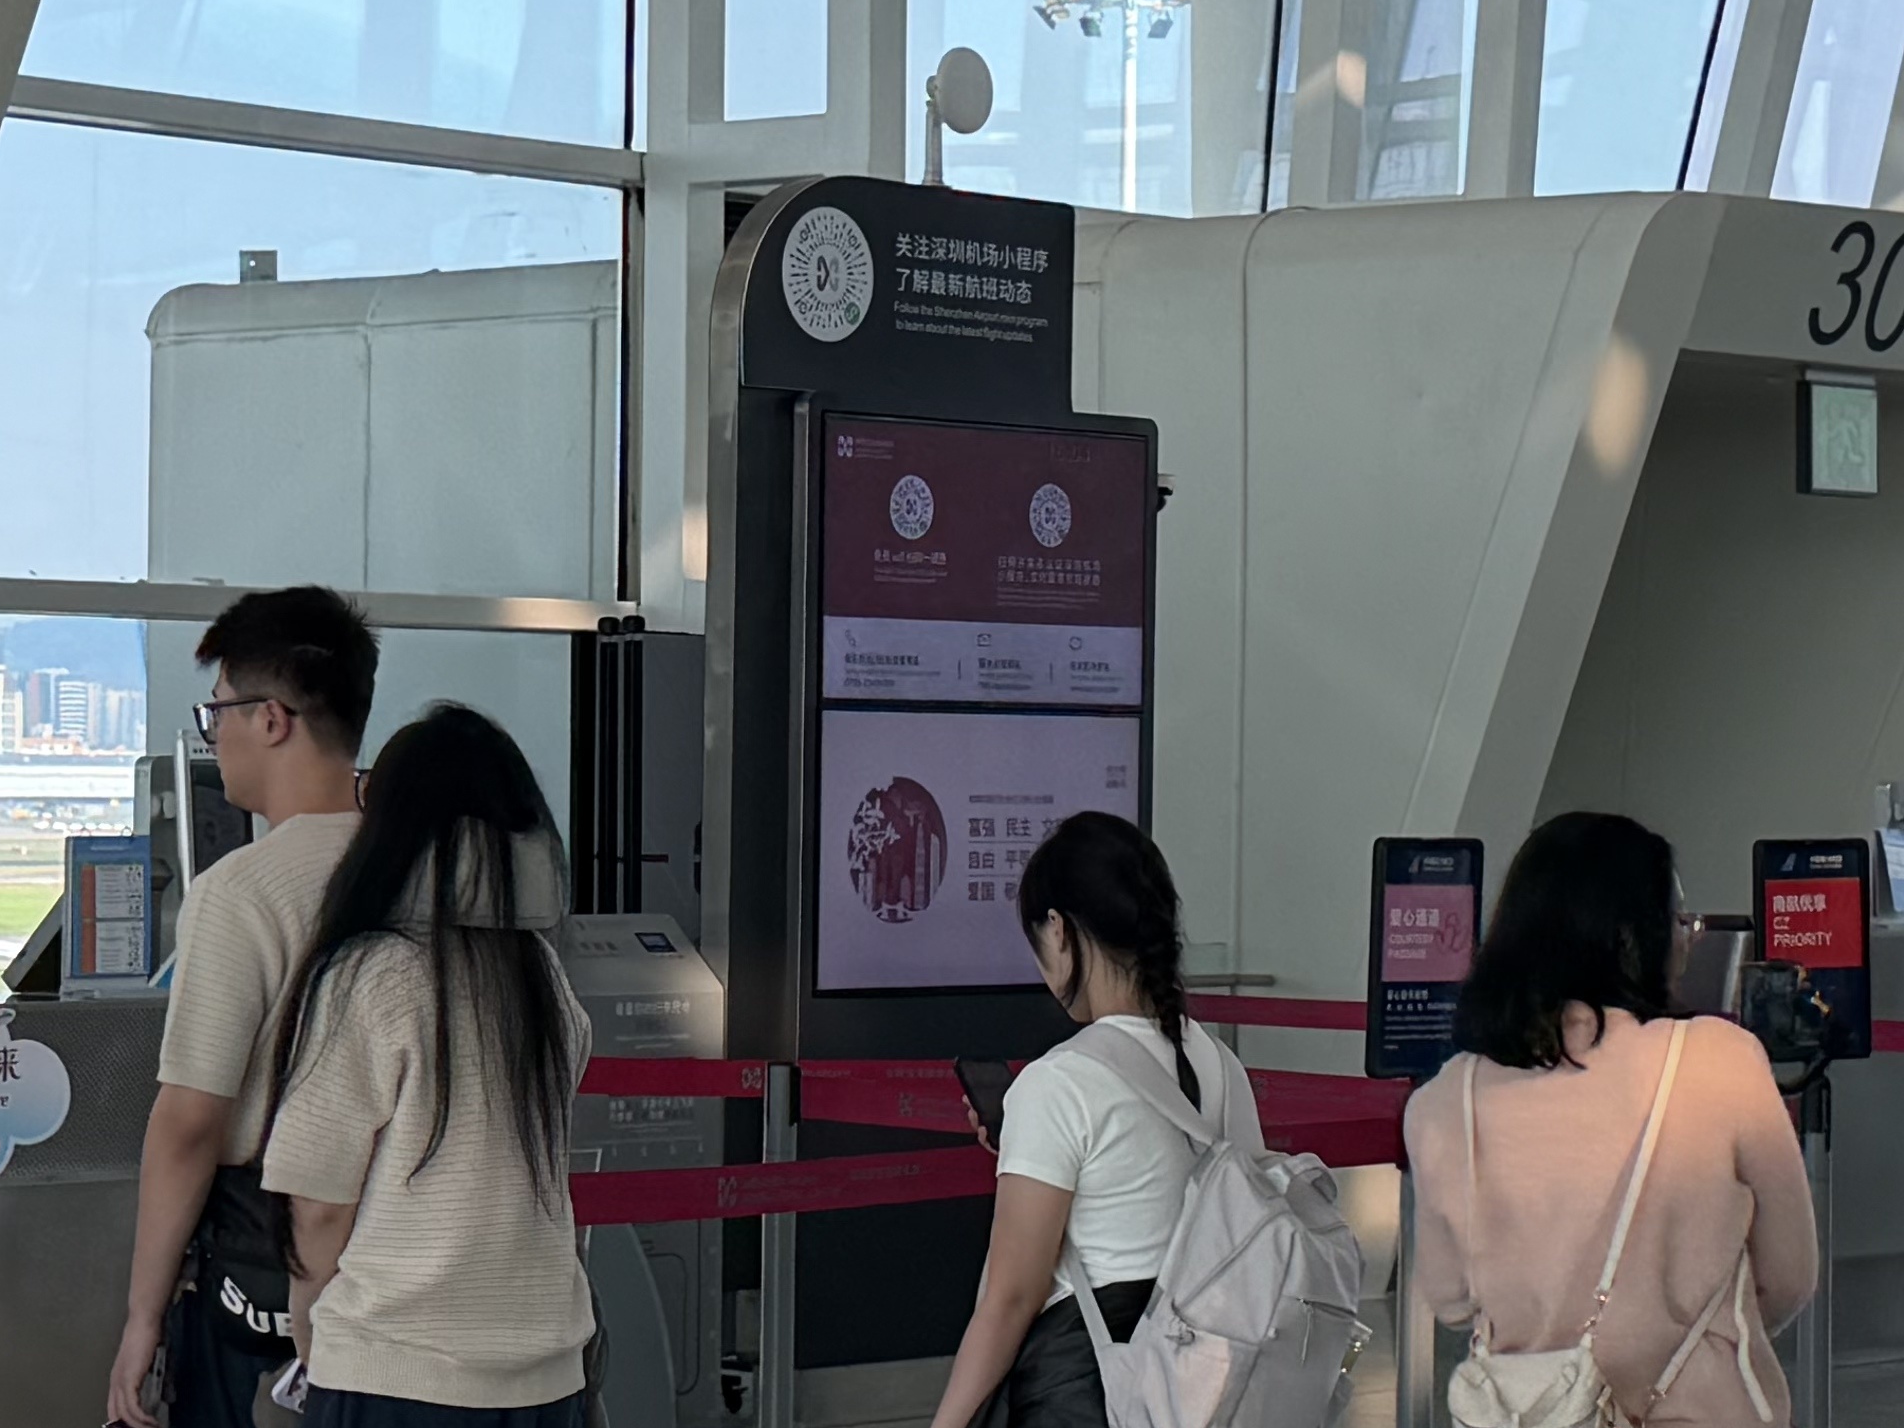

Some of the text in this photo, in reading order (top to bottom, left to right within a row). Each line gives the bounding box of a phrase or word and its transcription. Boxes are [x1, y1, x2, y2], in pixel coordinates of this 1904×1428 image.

[896, 232, 1049, 274] 关注深圳机场小程序
[896, 268, 1033, 304] 了解最新航班动态
[1774, 932, 1832, 947] PRIORITY
